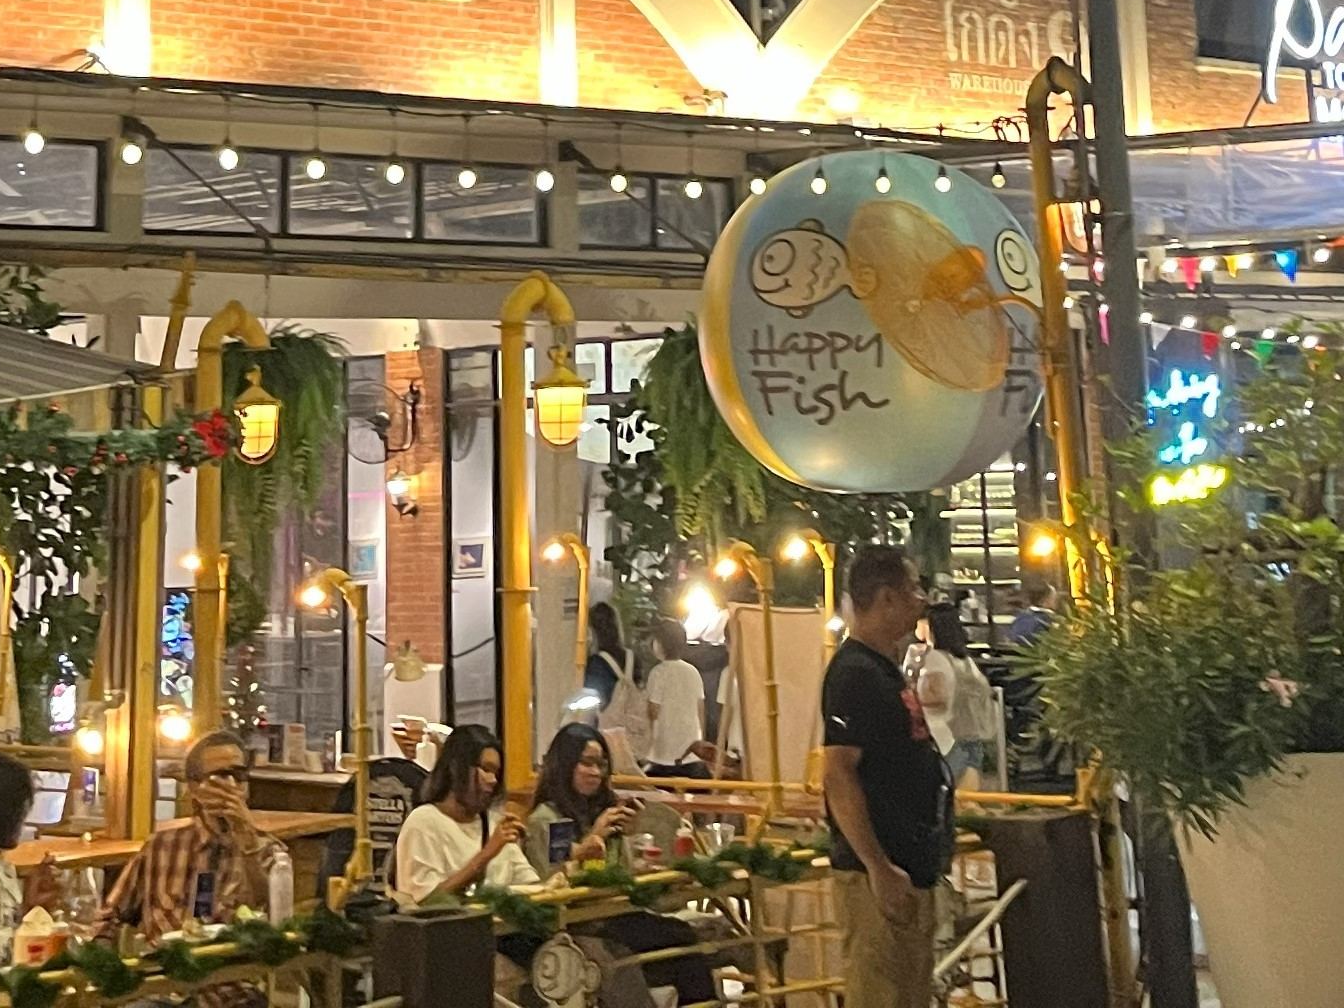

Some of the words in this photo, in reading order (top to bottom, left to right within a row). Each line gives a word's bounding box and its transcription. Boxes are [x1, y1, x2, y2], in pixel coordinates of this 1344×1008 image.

[948, 73, 1031, 96] WAREHOU
[749, 324, 885, 372] Happy
[751, 369, 891, 426] Fish
